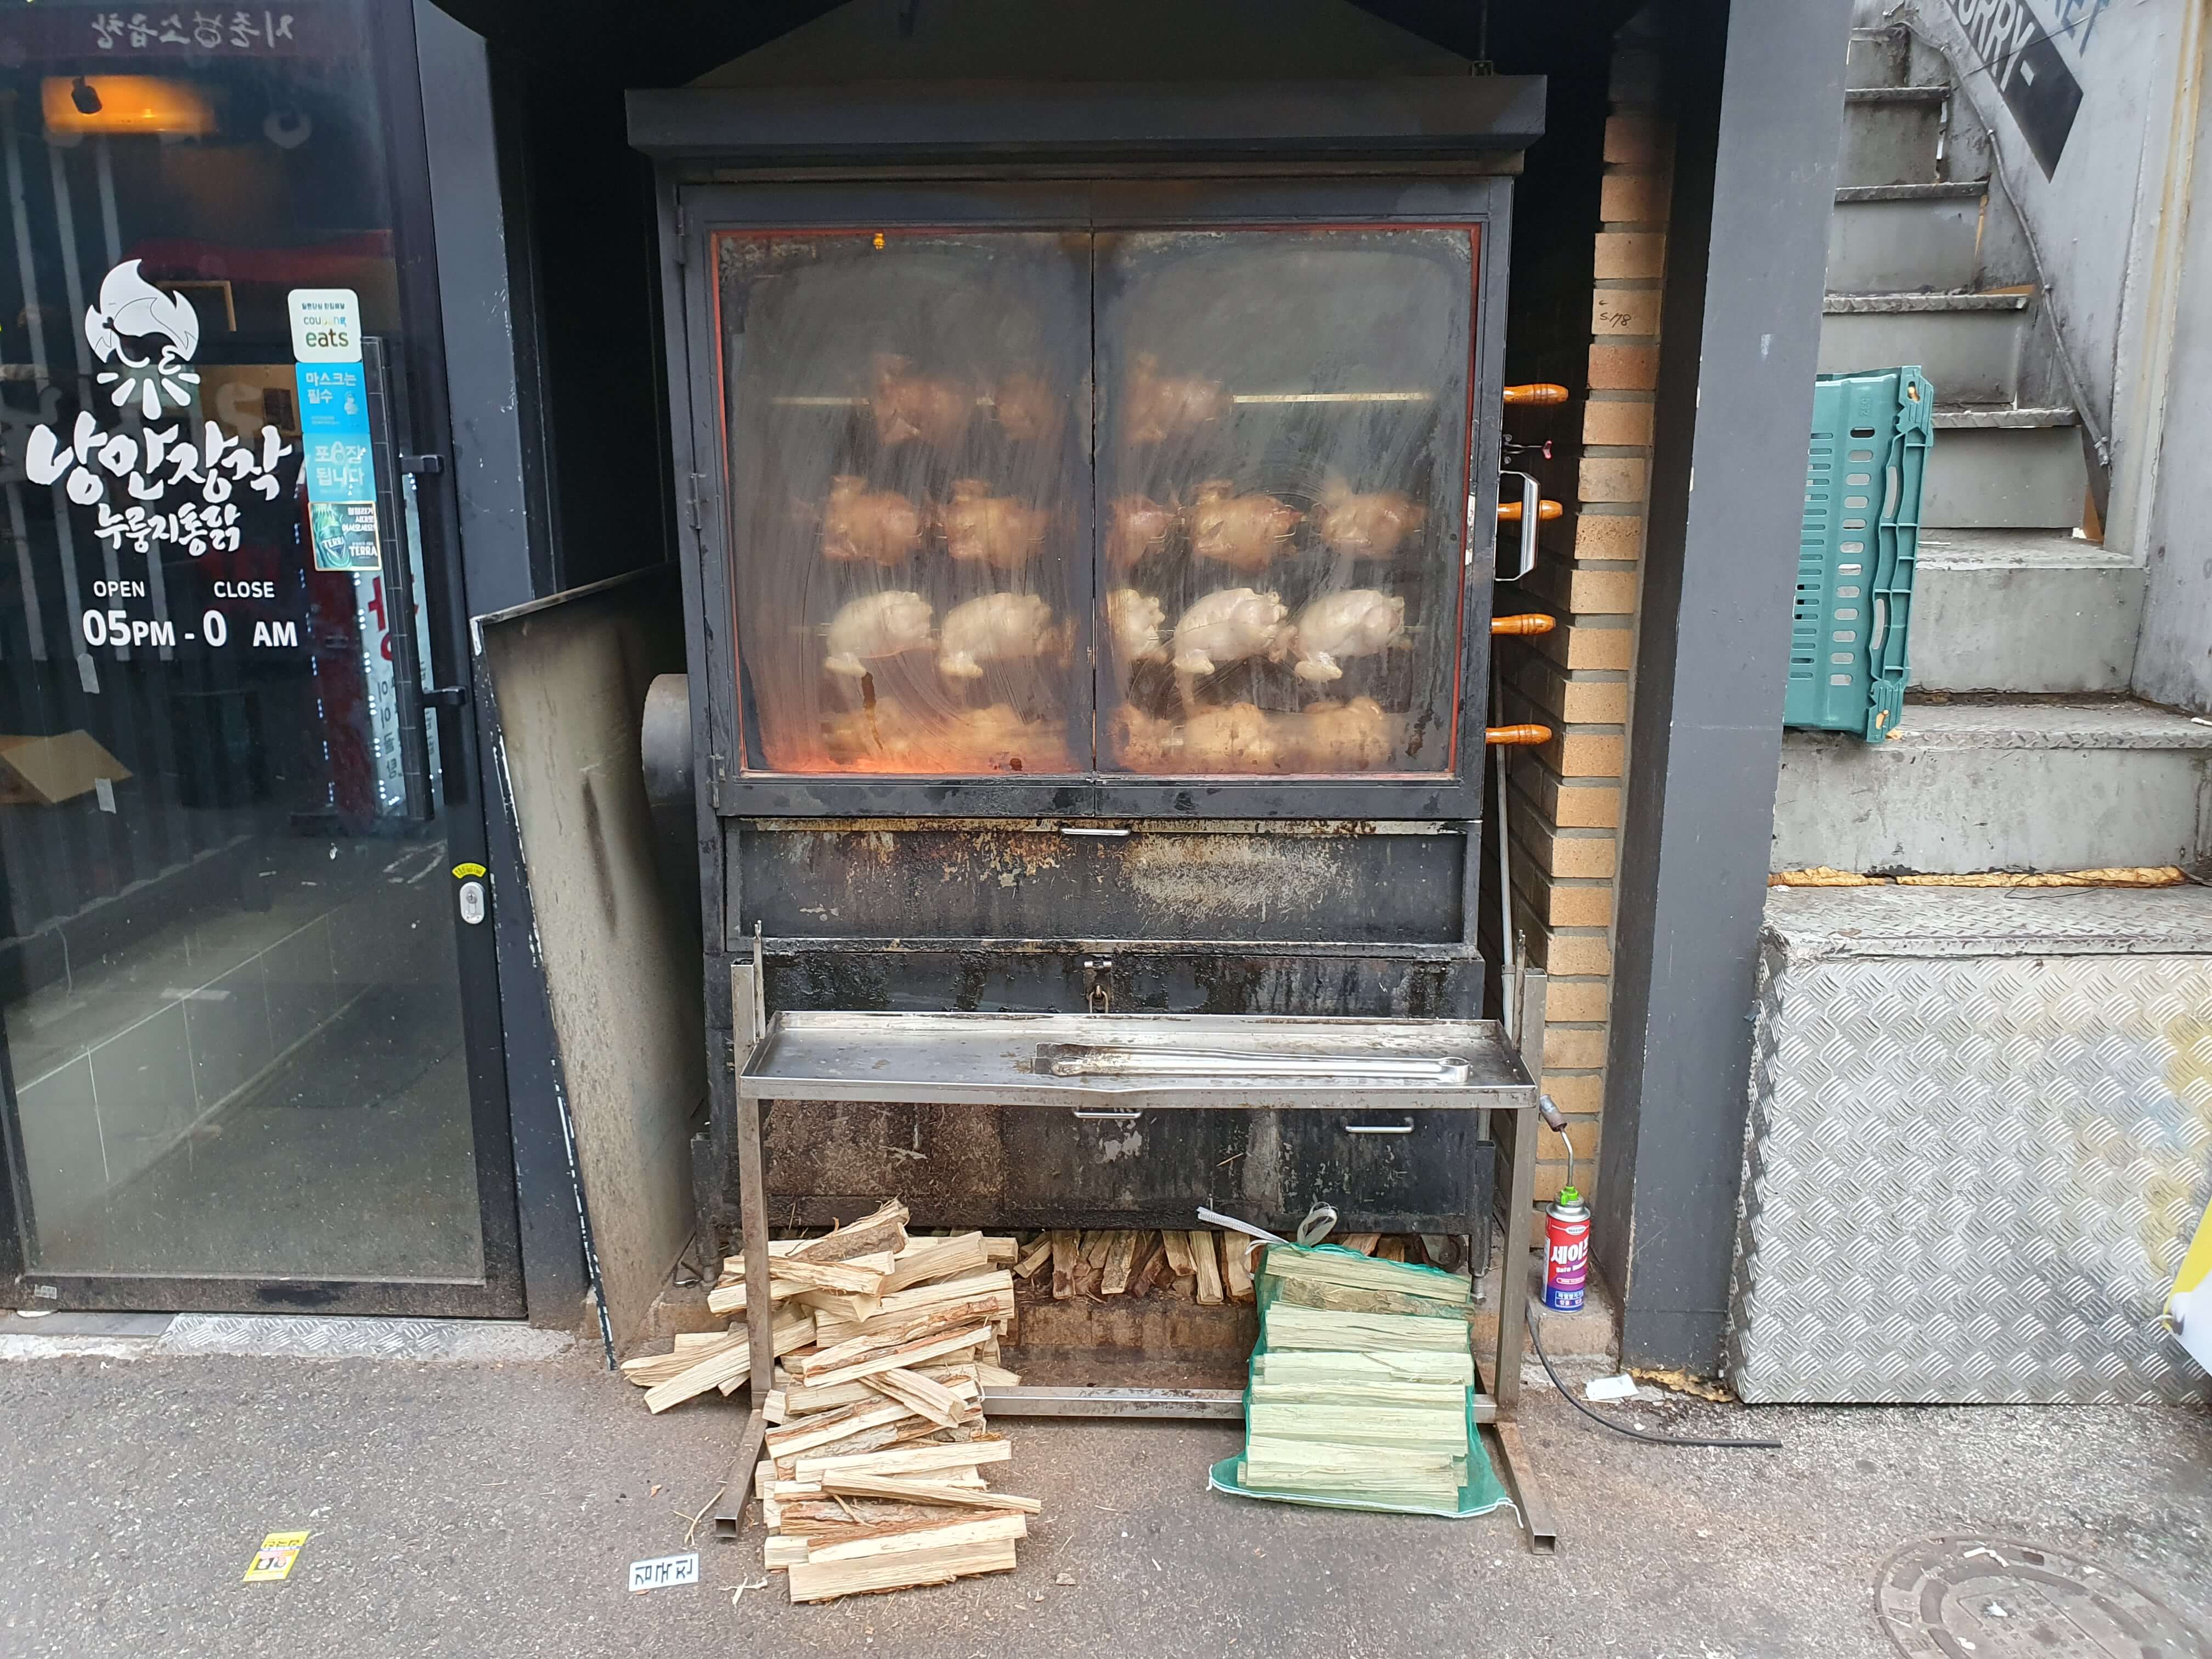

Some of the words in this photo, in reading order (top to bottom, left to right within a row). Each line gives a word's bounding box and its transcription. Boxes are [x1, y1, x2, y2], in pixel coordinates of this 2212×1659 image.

[303, 316, 347, 327] coung
[306, 328, 349, 347] eats
[306, 371, 357, 386] 마스크는
[307, 389, 333, 404] 필수
[316, 466, 364, 487] 됩니다
[94, 501, 241, 556] 누룽지통닭
[349, 545, 378, 557] TERRA
[93, 580, 145, 597] OPEN
[213, 581, 275, 597] CLOSE
[82, 610, 176, 646] 05PM
[253, 621, 298, 647] AM
